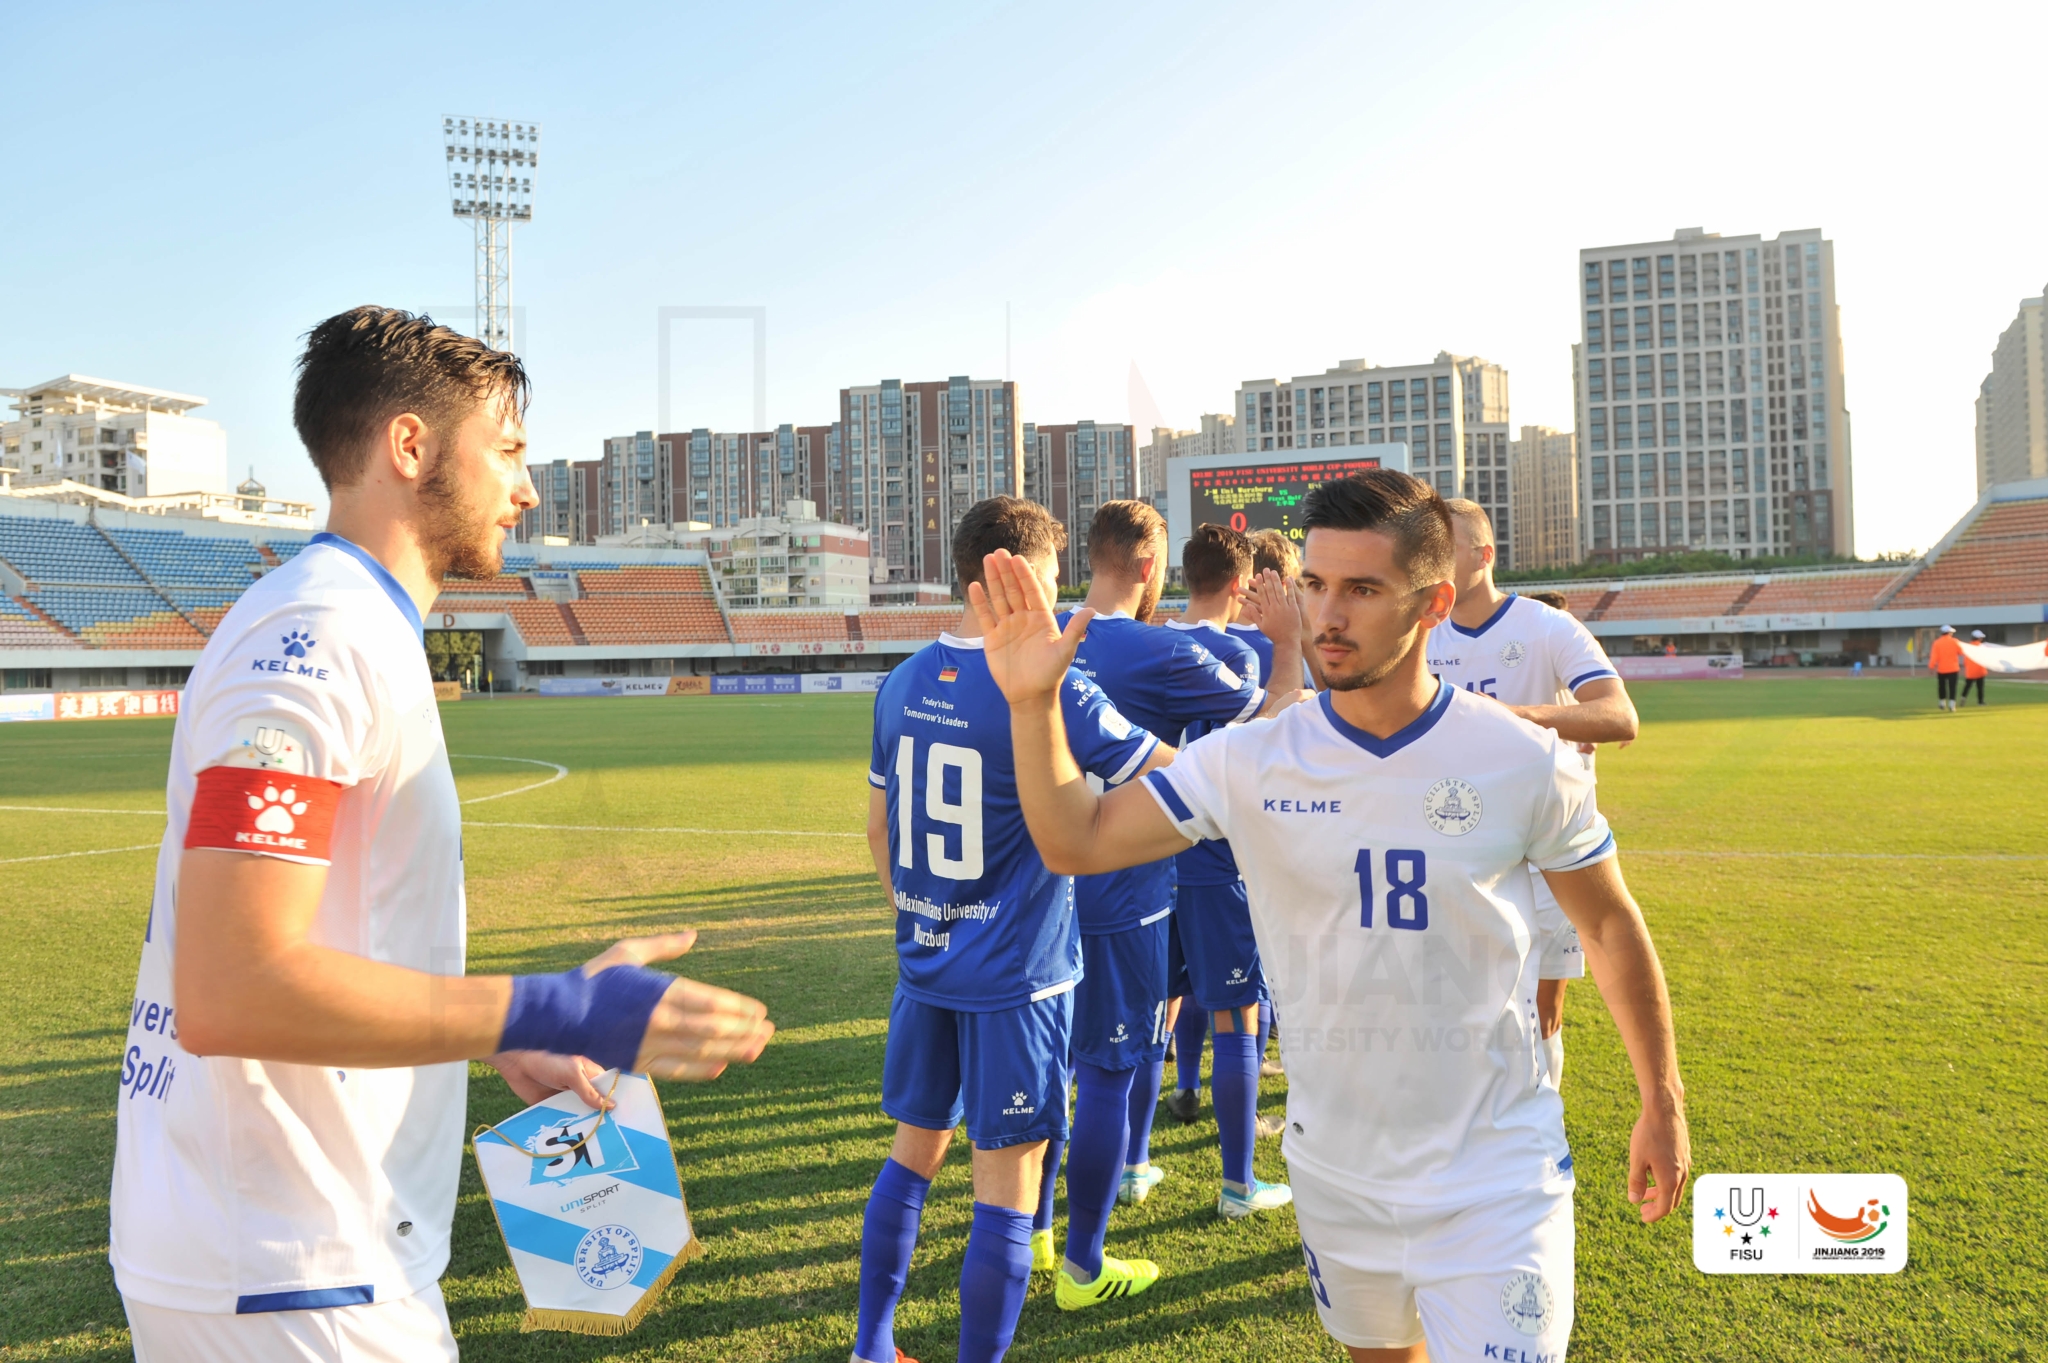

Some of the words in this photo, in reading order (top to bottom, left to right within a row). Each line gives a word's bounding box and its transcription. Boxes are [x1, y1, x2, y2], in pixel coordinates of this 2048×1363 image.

[1256, 466, 1298, 474] UNIVERSITY
[1302, 464, 1324, 472] WORLD
[1230, 512, 1247, 533] 0
[442, 614, 455, 628] D
[252, 659, 329, 681] KELME
[922, 696, 941, 709] Today's
[941, 700, 954, 711] Stars
[903, 706, 942, 724] Tomorrow's
[942, 715, 969, 729] Leaders
[895, 735, 984, 880] 19
[1263, 799, 1342, 813] KELME
[235, 832, 307, 849] KELME
[1354, 848, 1428, 931] 18
[943, 900, 990, 924] University
[989, 901, 1001, 919] of
[914, 922, 950, 952] Wurzburg
[1002, 1106, 1035, 1115] KELME
[580, 1200, 606, 1213] SPLIT
[579, 1227, 612, 1287] UNIVERSITY
[615, 1228, 630, 1238] OF
[628, 1239, 639, 1276] SPLIT
